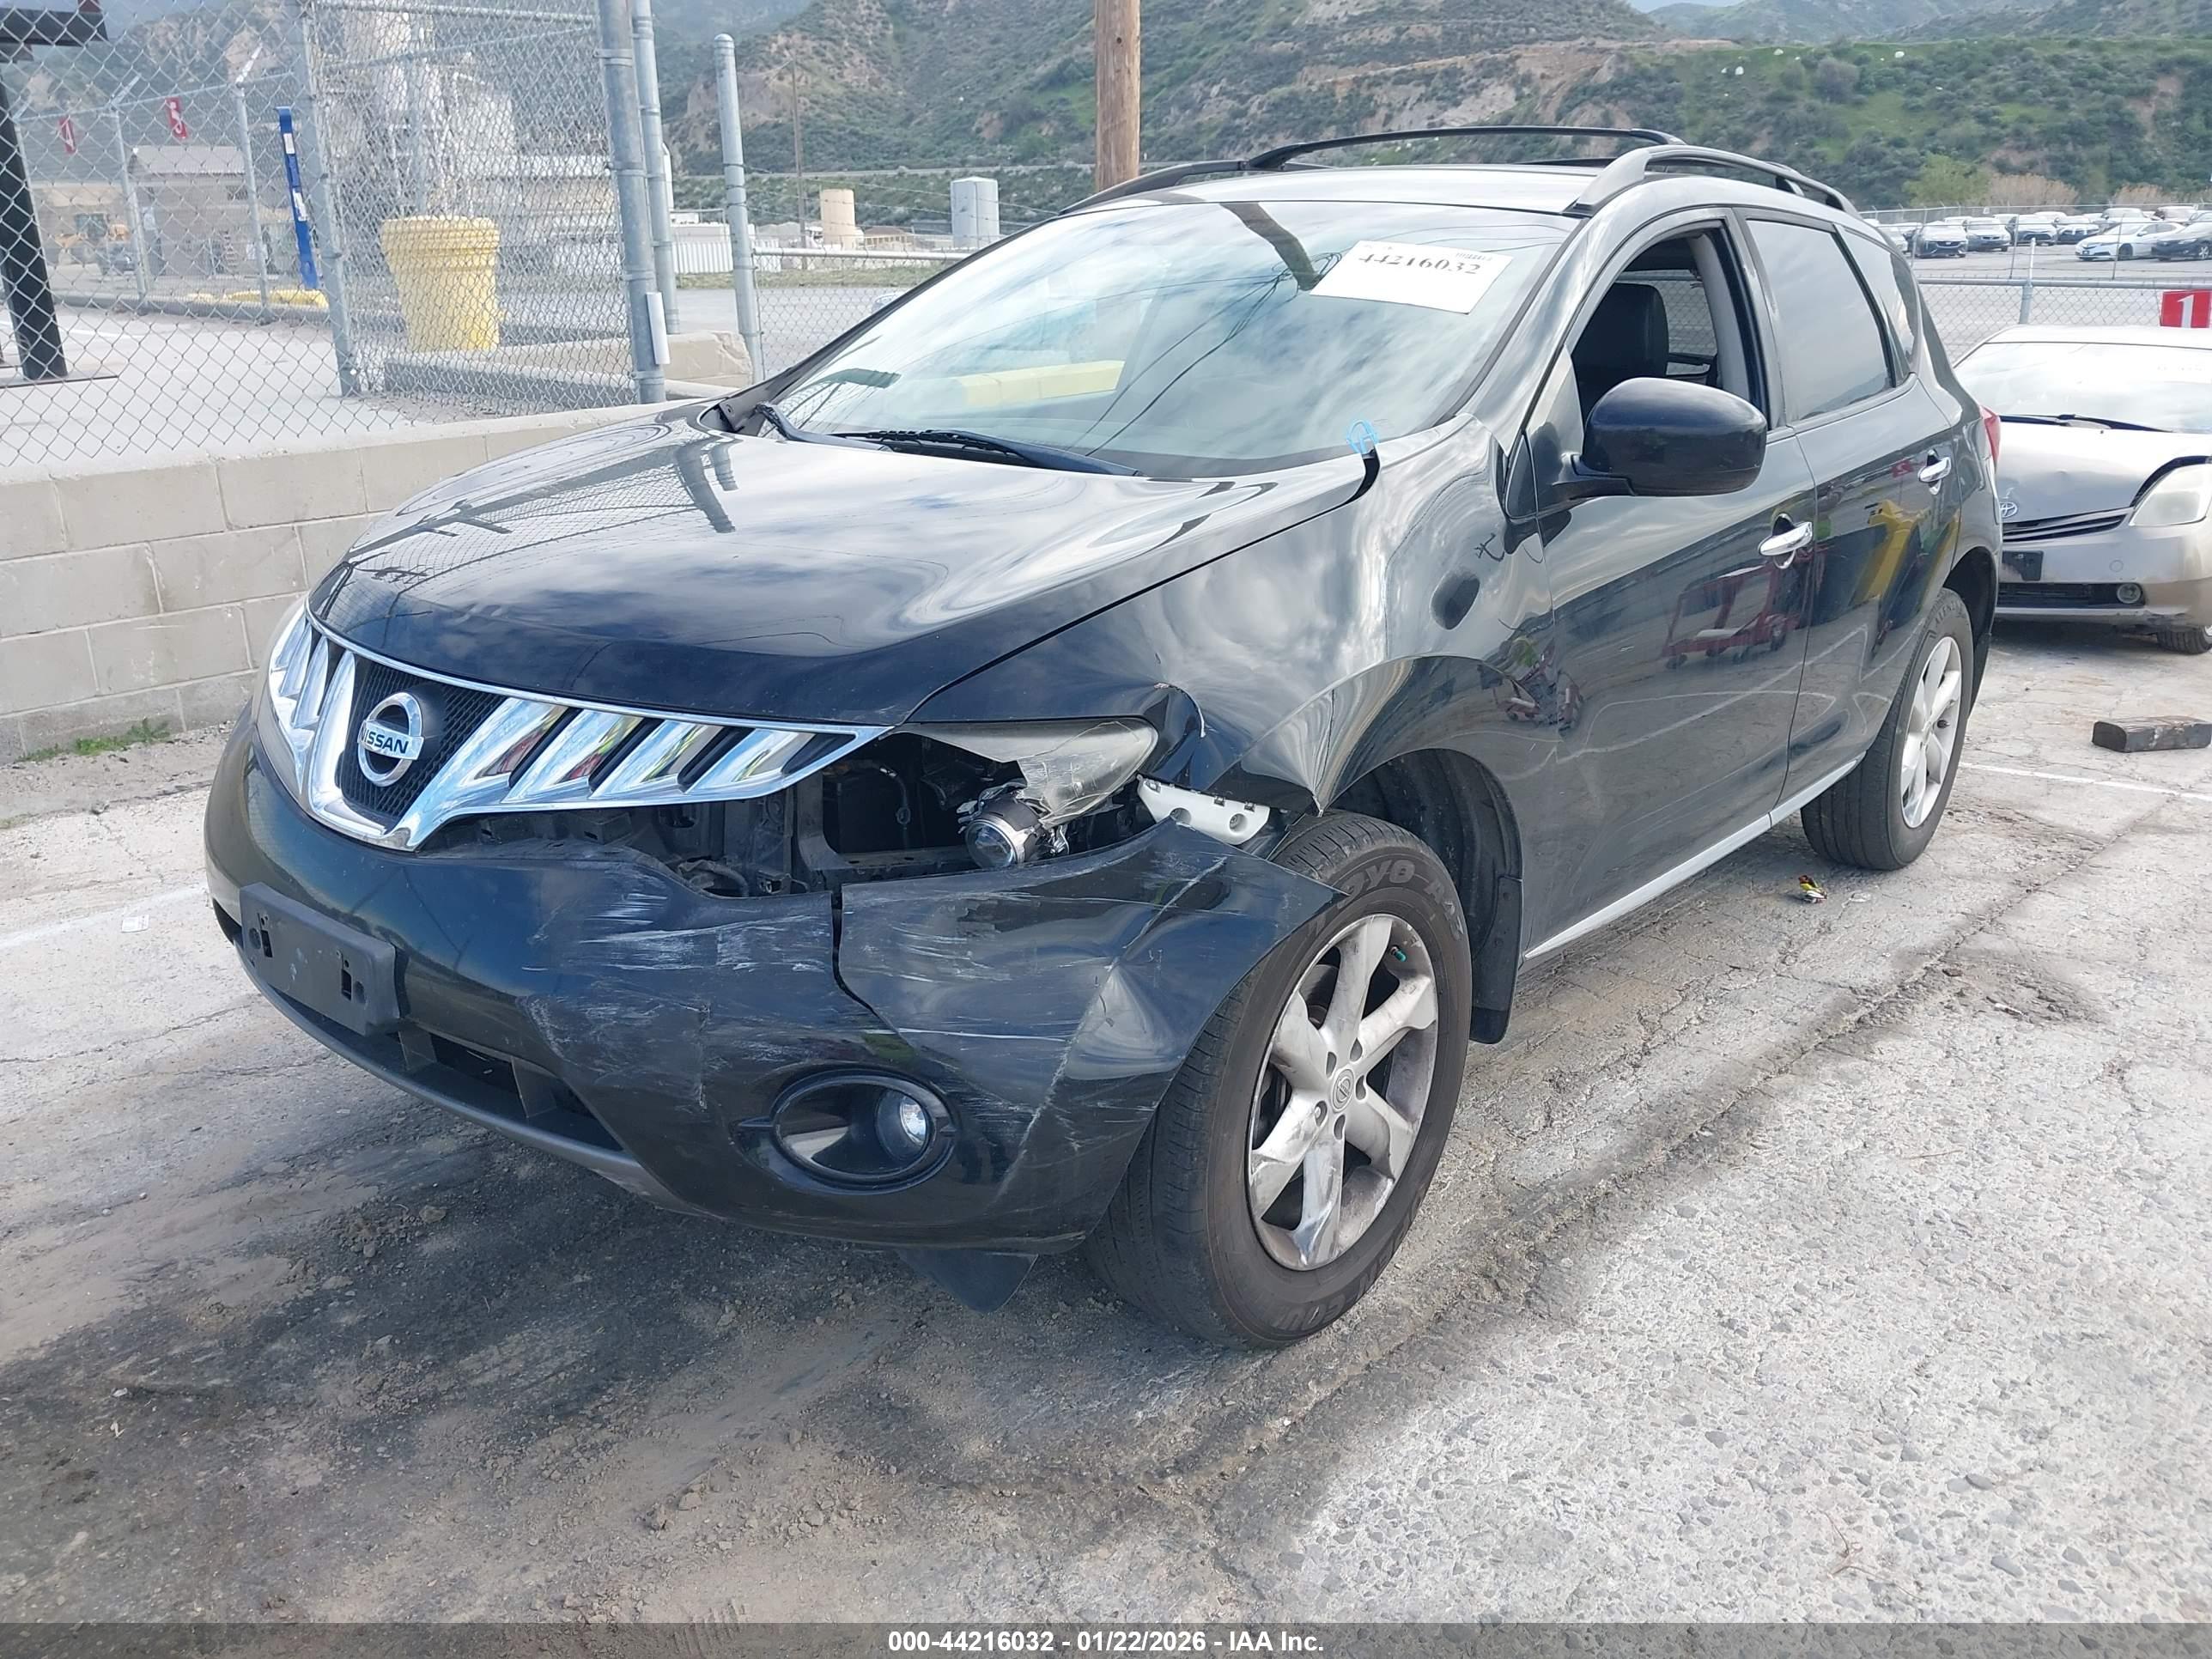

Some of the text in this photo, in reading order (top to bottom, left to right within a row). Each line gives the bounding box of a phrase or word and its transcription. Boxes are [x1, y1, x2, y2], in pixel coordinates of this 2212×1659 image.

[1358, 253, 1481, 275] 44216032
[2178, 295, 2195, 328] 1
[361, 726, 409, 754] NISSAN
